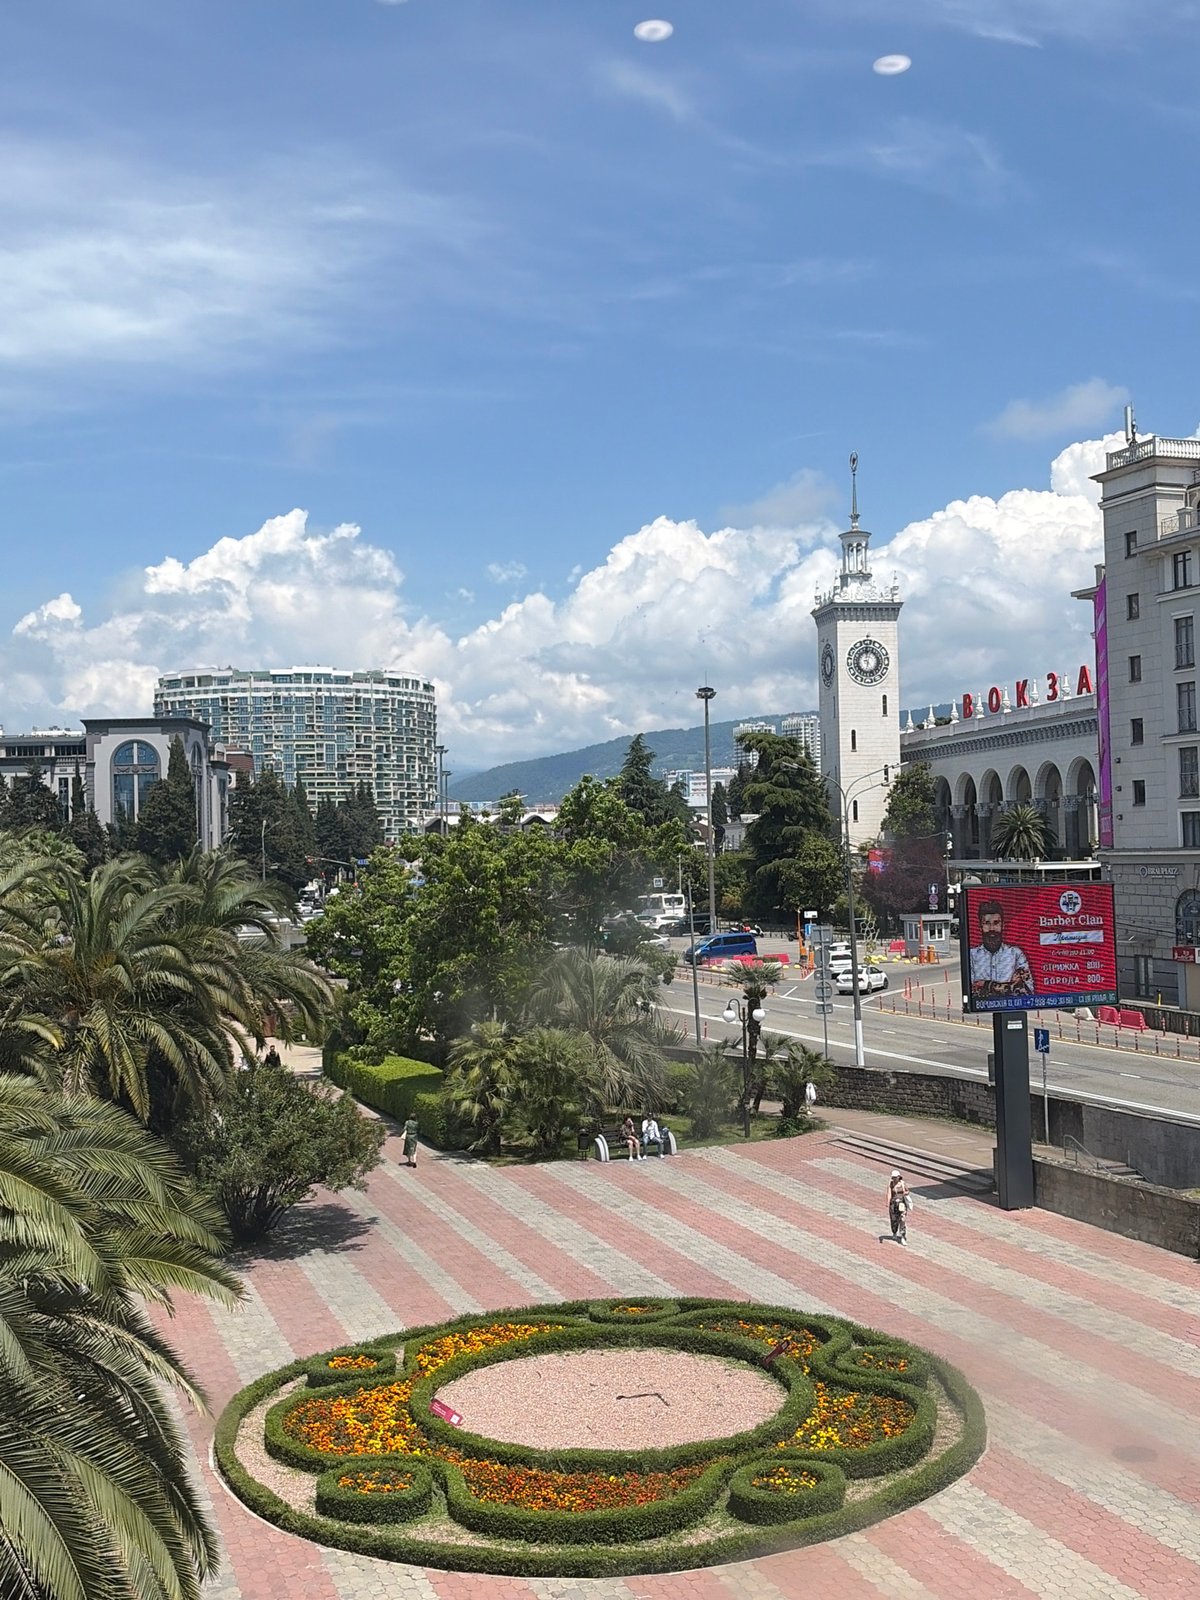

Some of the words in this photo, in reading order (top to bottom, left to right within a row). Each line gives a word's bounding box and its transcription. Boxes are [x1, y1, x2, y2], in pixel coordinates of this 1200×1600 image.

[1039, 915, 1077, 926] Barber
[1078, 914, 1103, 925] Clan
[1043, 963, 1079, 972] СТРИЖКА
[1043, 977, 1080, 985] БОРОДА
